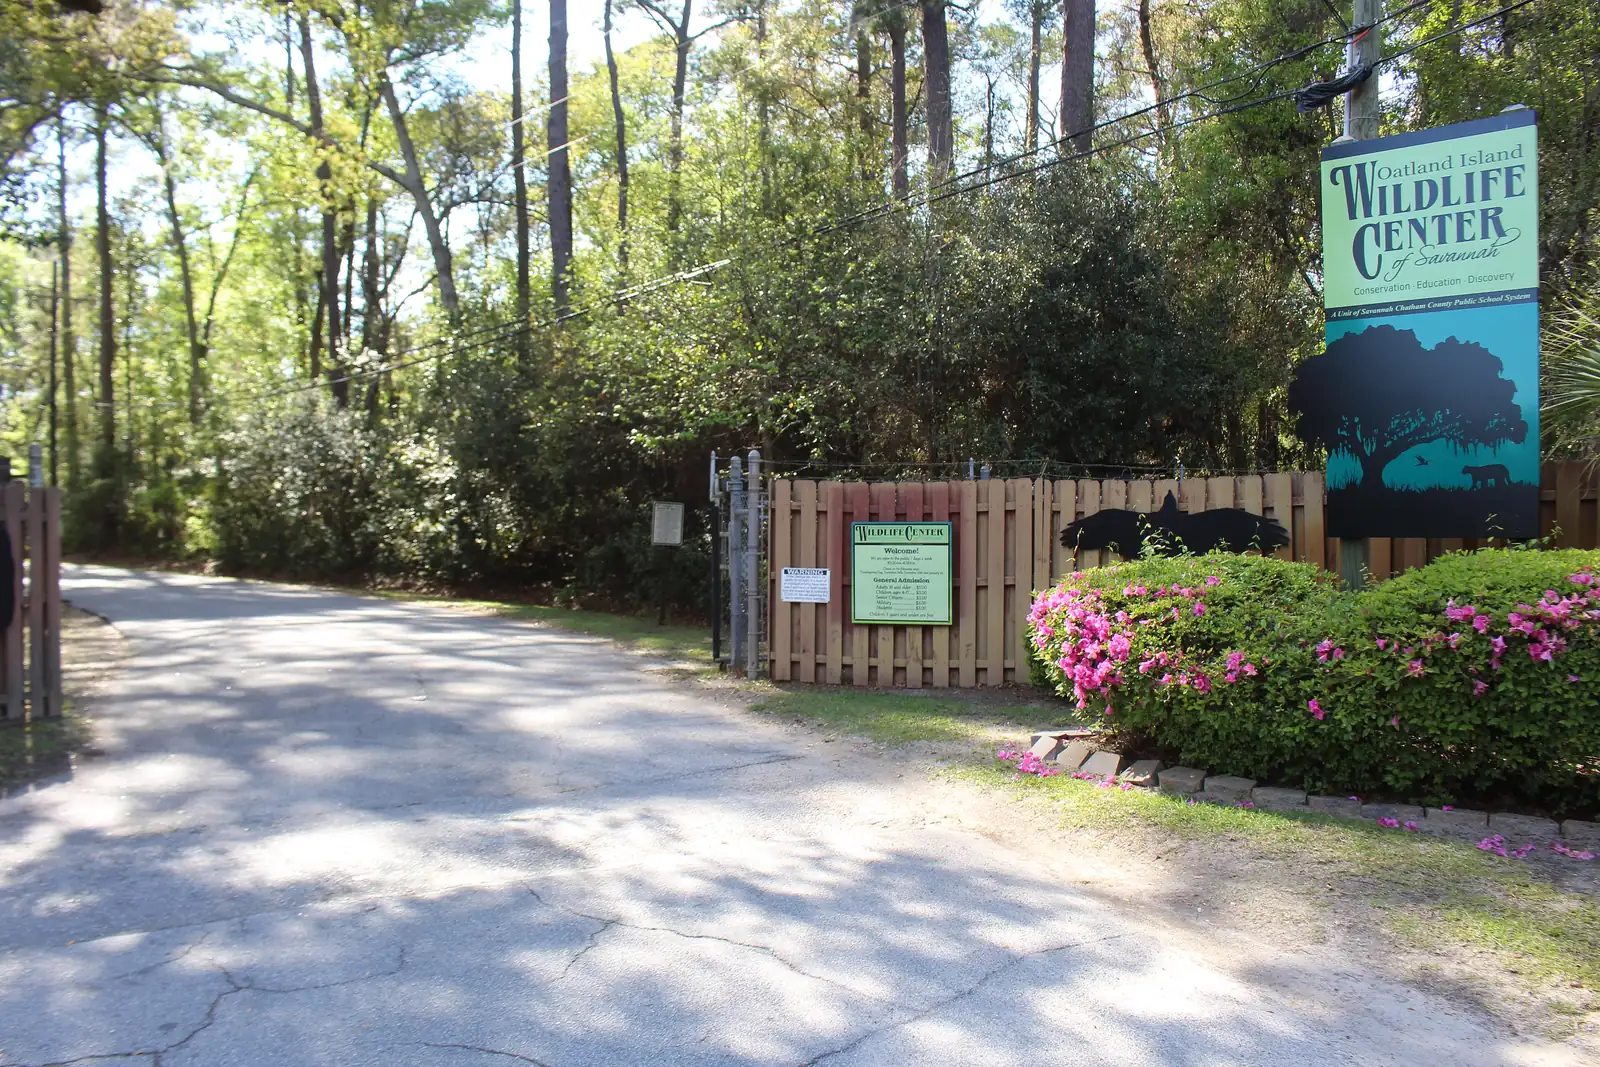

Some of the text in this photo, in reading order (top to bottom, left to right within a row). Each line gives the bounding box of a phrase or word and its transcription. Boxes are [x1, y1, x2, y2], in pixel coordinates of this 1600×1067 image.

[1377, 144, 1524, 180] Oatland Island
[1330, 160, 1526, 220] WILDLIFE
[1352, 206, 1508, 280] CENTER
[1384, 228, 1521, 282] of Savannah
[1338, 309, 1352, 317] Unit
[1353, 308, 1360, 316] of
[1361, 306, 1394, 314] Savannah
[1396, 303, 1426, 312] Chatham
[1428, 300, 1452, 309] County
[1454, 298, 1476, 306] Public
[1478, 295, 1502, 304] School
[1504, 293, 1530, 302] System
[1354, 272, 1514, 296] Conservation Education Discovery
